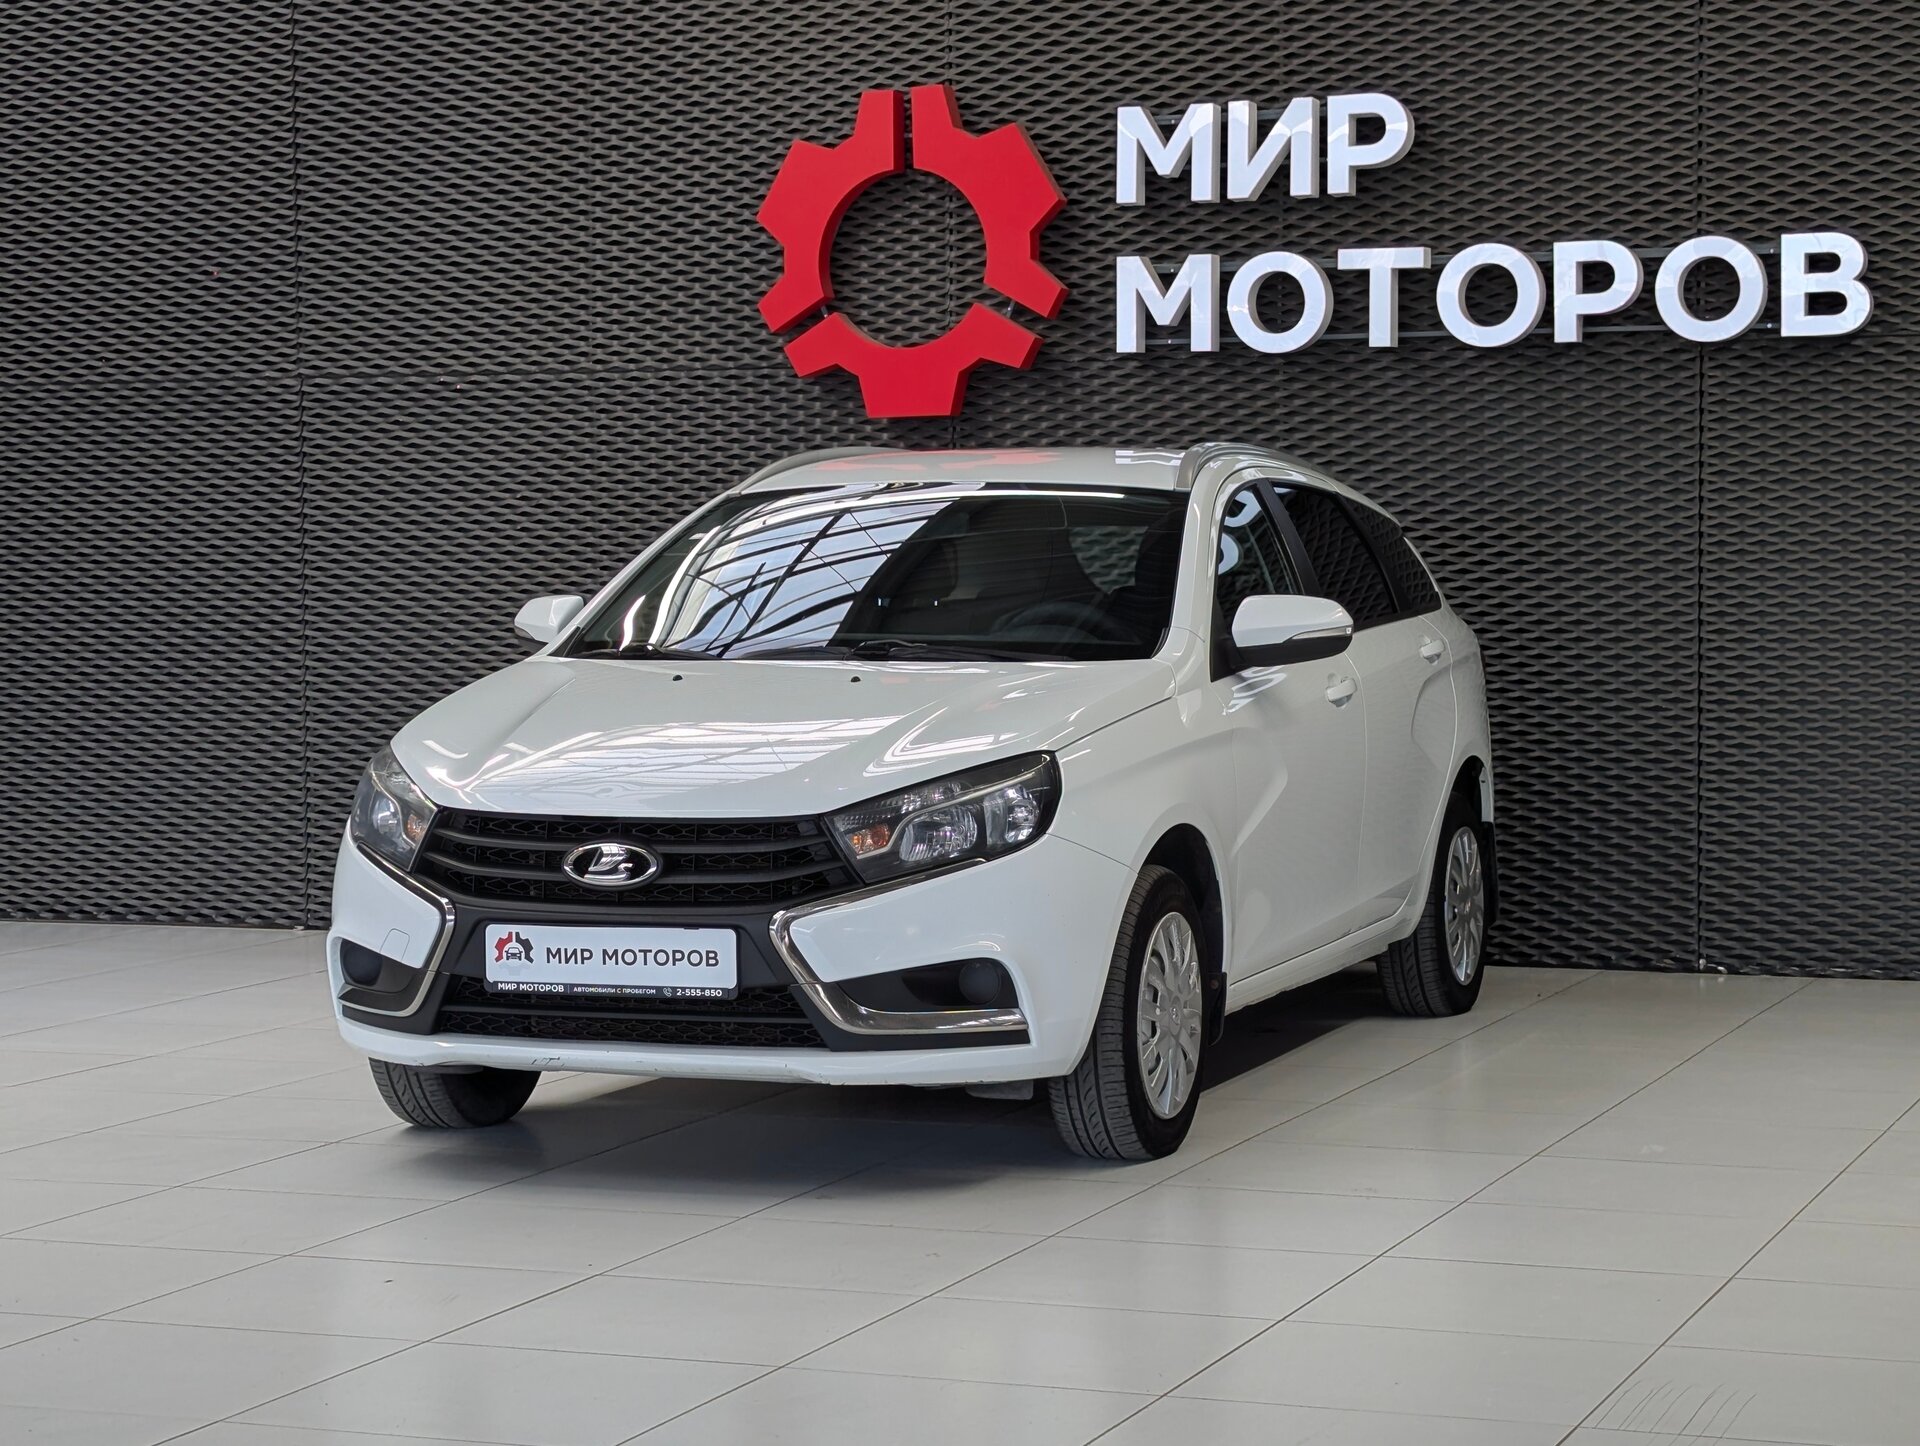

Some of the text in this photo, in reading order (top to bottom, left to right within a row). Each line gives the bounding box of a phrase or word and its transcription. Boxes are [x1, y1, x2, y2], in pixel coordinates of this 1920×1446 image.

[1116, 92, 1414, 206] МИР
[1116, 232, 1874, 354] МОТОРОВ
[498, 982, 517, 990] МИР
[519, 984, 564, 992] МОТОРОВ
[546, 947, 720, 967] МИР МОТОРОВ
